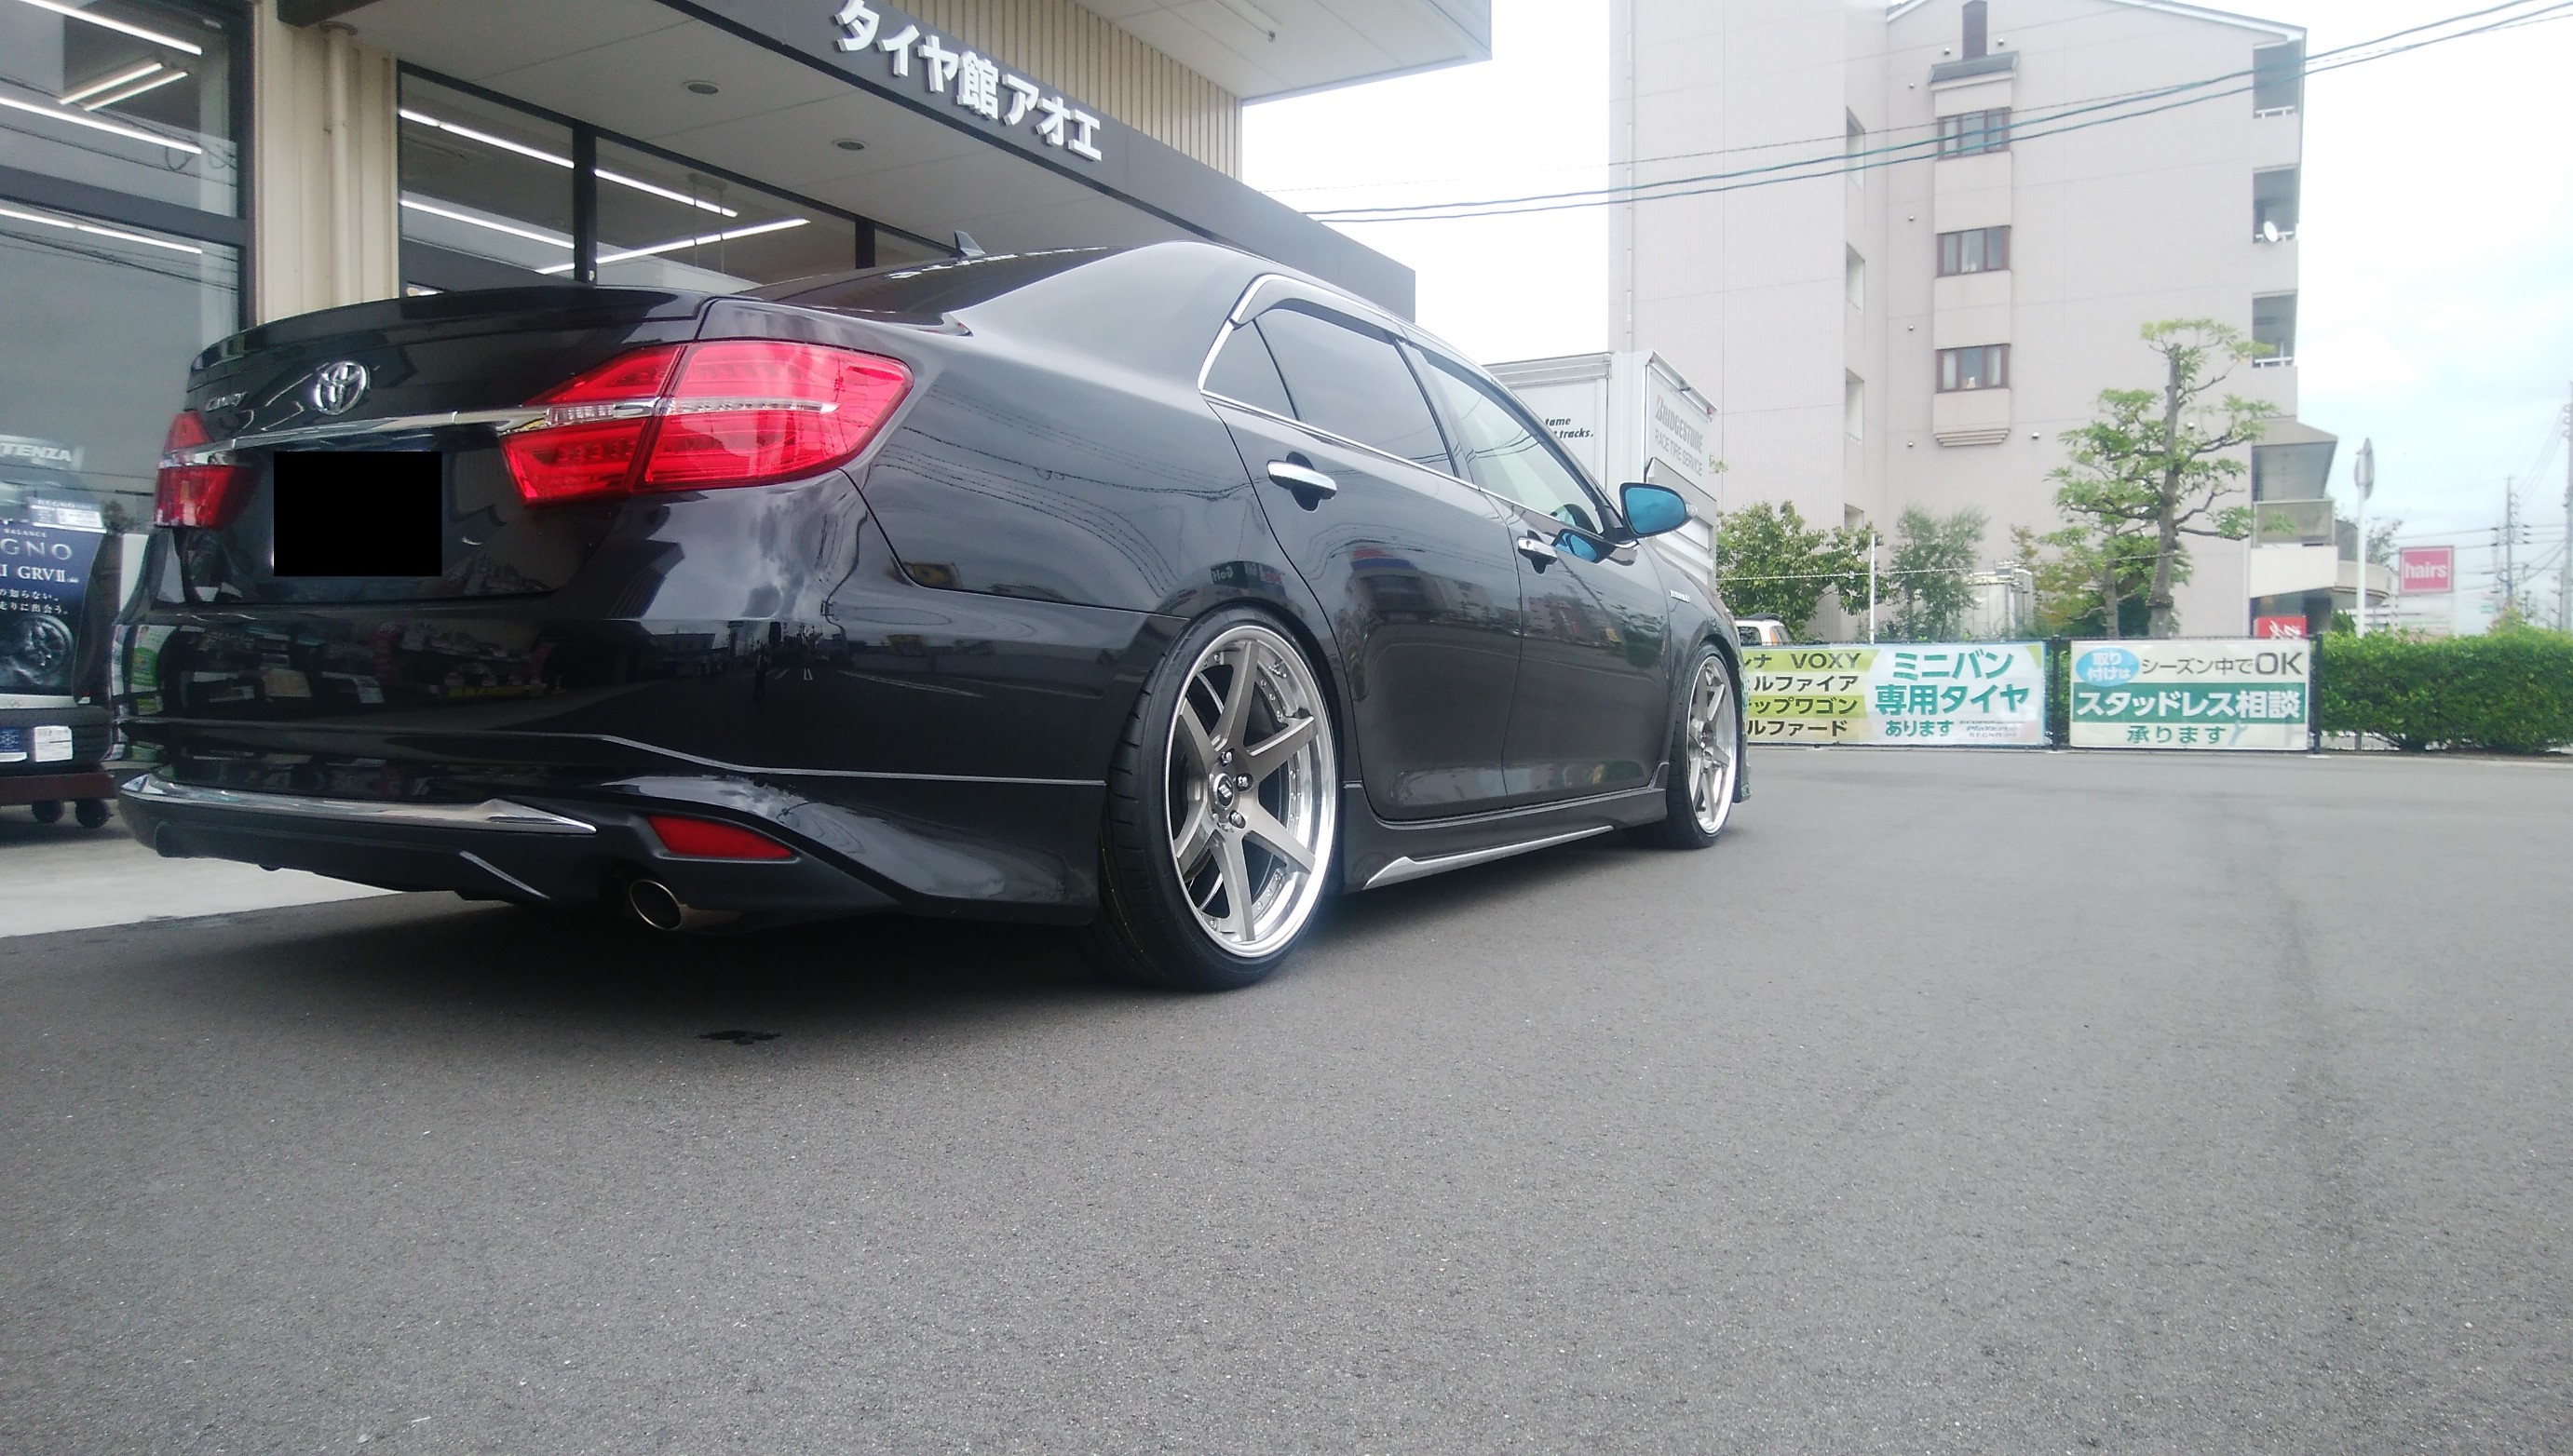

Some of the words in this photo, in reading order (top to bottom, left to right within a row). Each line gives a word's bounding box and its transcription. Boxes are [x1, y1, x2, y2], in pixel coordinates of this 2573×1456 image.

[835, 0, 1103, 162] タイヤ館アオエ
[1559, 427, 1594, 439] tracks.
[1655, 395, 1703, 454] BRIDGESTONE
[1655, 428, 1670, 452] RACE
[1670, 438, 1682, 462] TIRE
[1682, 450, 1703, 477] SERVICE
[2404, 561, 2448, 579] hairs
[1790, 653, 1862, 669] VOXY
[1893, 648, 2014, 681] ミニバン
[2092, 651, 2122, 667] 取り
[2142, 652, 2304, 676] シーズン中でOK
[2087, 667, 2132, 682] 付けは
[1748, 696, 1859, 714] ップワゴン
[1875, 683, 2030, 716] 専用タイヤ
[2077, 690, 2301, 720] スタッドレス相談
[1885, 720, 1955, 738] あります
[2126, 724, 2226, 745] 承ります
